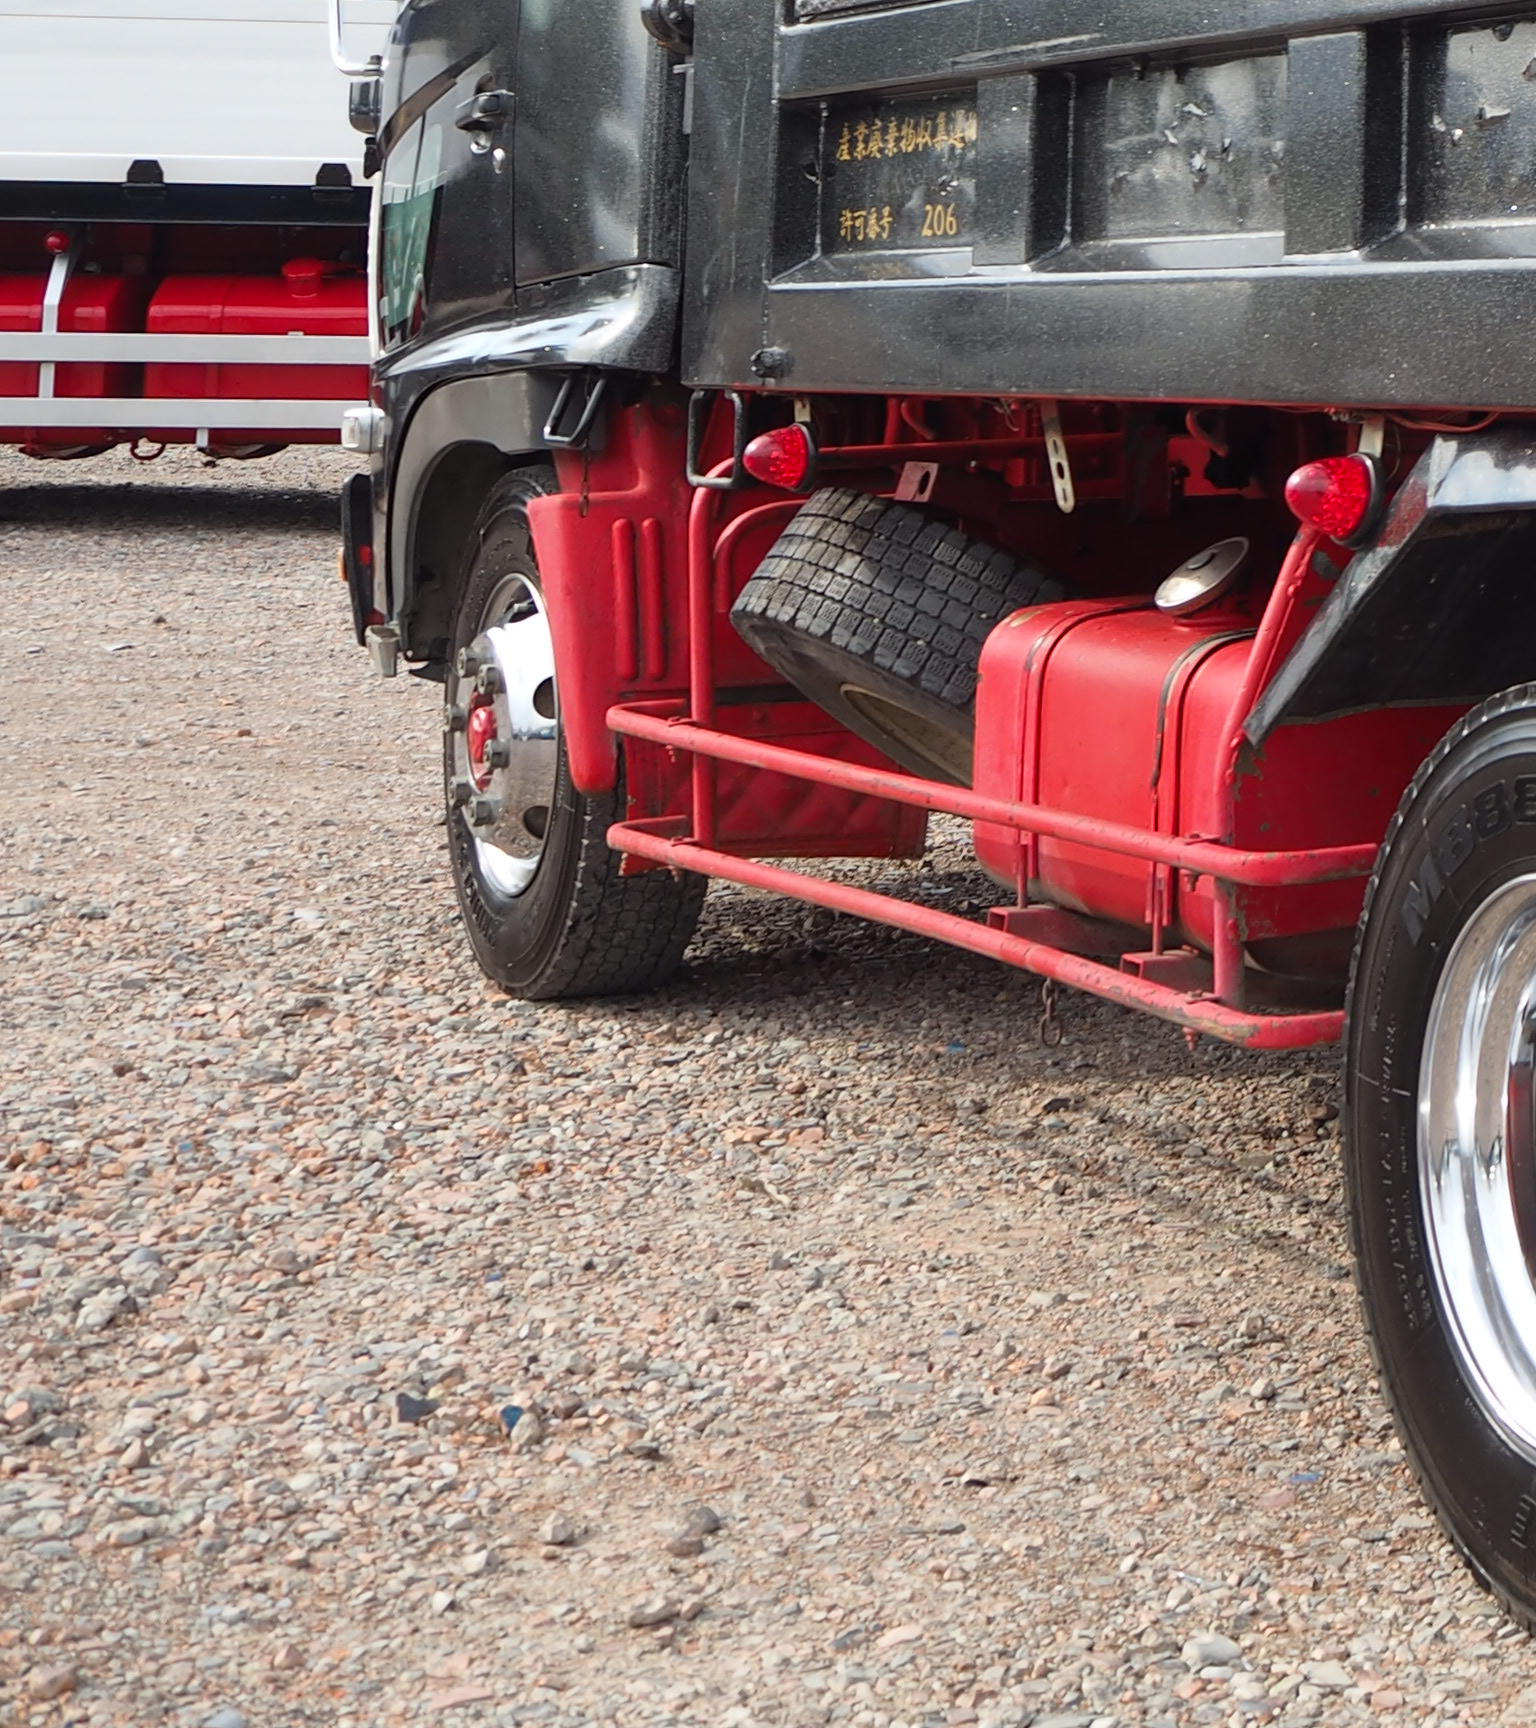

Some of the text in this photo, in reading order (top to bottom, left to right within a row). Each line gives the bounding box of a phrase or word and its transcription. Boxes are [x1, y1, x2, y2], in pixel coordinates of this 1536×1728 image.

[839, 202, 958, 242] 許可番号 206
